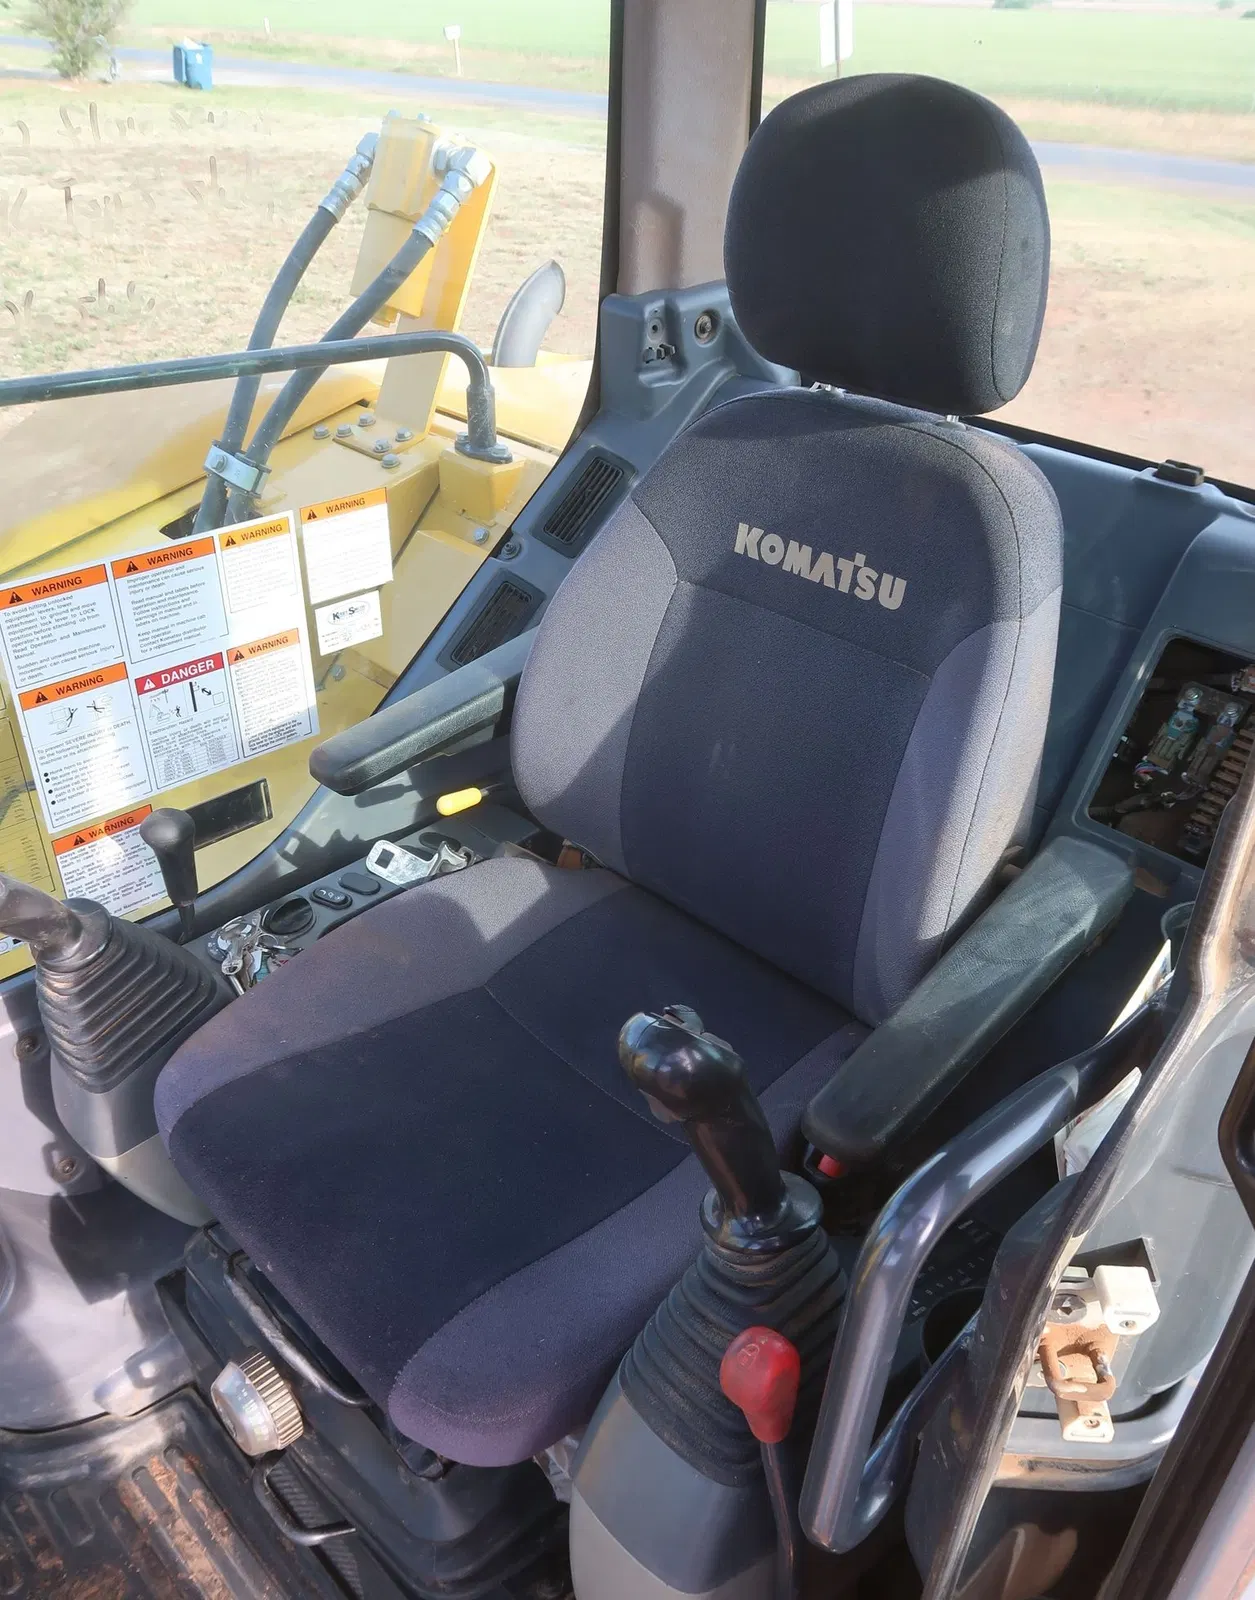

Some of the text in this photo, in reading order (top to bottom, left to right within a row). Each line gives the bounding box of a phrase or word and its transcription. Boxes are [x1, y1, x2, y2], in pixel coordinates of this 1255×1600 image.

[326, 498, 366, 514] WARNING
[240, 524, 283, 541] WARNING
[147, 548, 193, 566] WARNING
[734, 522, 907, 610] KOMATSU
[127, 575, 149, 583] Improper
[151, 568, 174, 577] operation
[32, 576, 82, 596] WARNING
[12, 607, 27, 615] avoid
[48, 595, 73, 605] unlocked
[145, 593, 163, 601] manual
[132, 602, 156, 611] operation
[135, 613, 157, 622] warnings
[164, 605, 182, 613] manual
[151, 601, 180, 611] instructions
[5, 612, 35, 623] equipment
[7, 618, 38, 630] attachment
[49, 609, 69, 619] ground
[8, 624, 38, 636] equipment
[79, 608, 95, 616] LOCK
[151, 625, 169, 633] manual
[176, 617, 196, 625] machine
[10, 633, 33, 642] position
[52, 620, 76, 630] standing
[140, 626, 206, 648] Contact Komatsu distributor
[11, 637, 39, 648] operator's
[30, 639, 57, 649] Operation
[153, 638, 182, 649] replacement
[248, 636, 289, 654] WARNING
[17, 661, 38, 670] Sudden
[51, 649, 77, 660] unwanted
[78, 643, 100, 651] machine
[78, 650, 97, 658] serious
[161, 659, 215, 685] DANGER
[56, 674, 104, 696] WARNING
[45, 743, 64, 753] prevent
[65, 735, 86, 745] SEVERE
[56, 744, 79, 754] following
[40, 756, 62, 766] machine
[88, 816, 134, 838] WARNING
